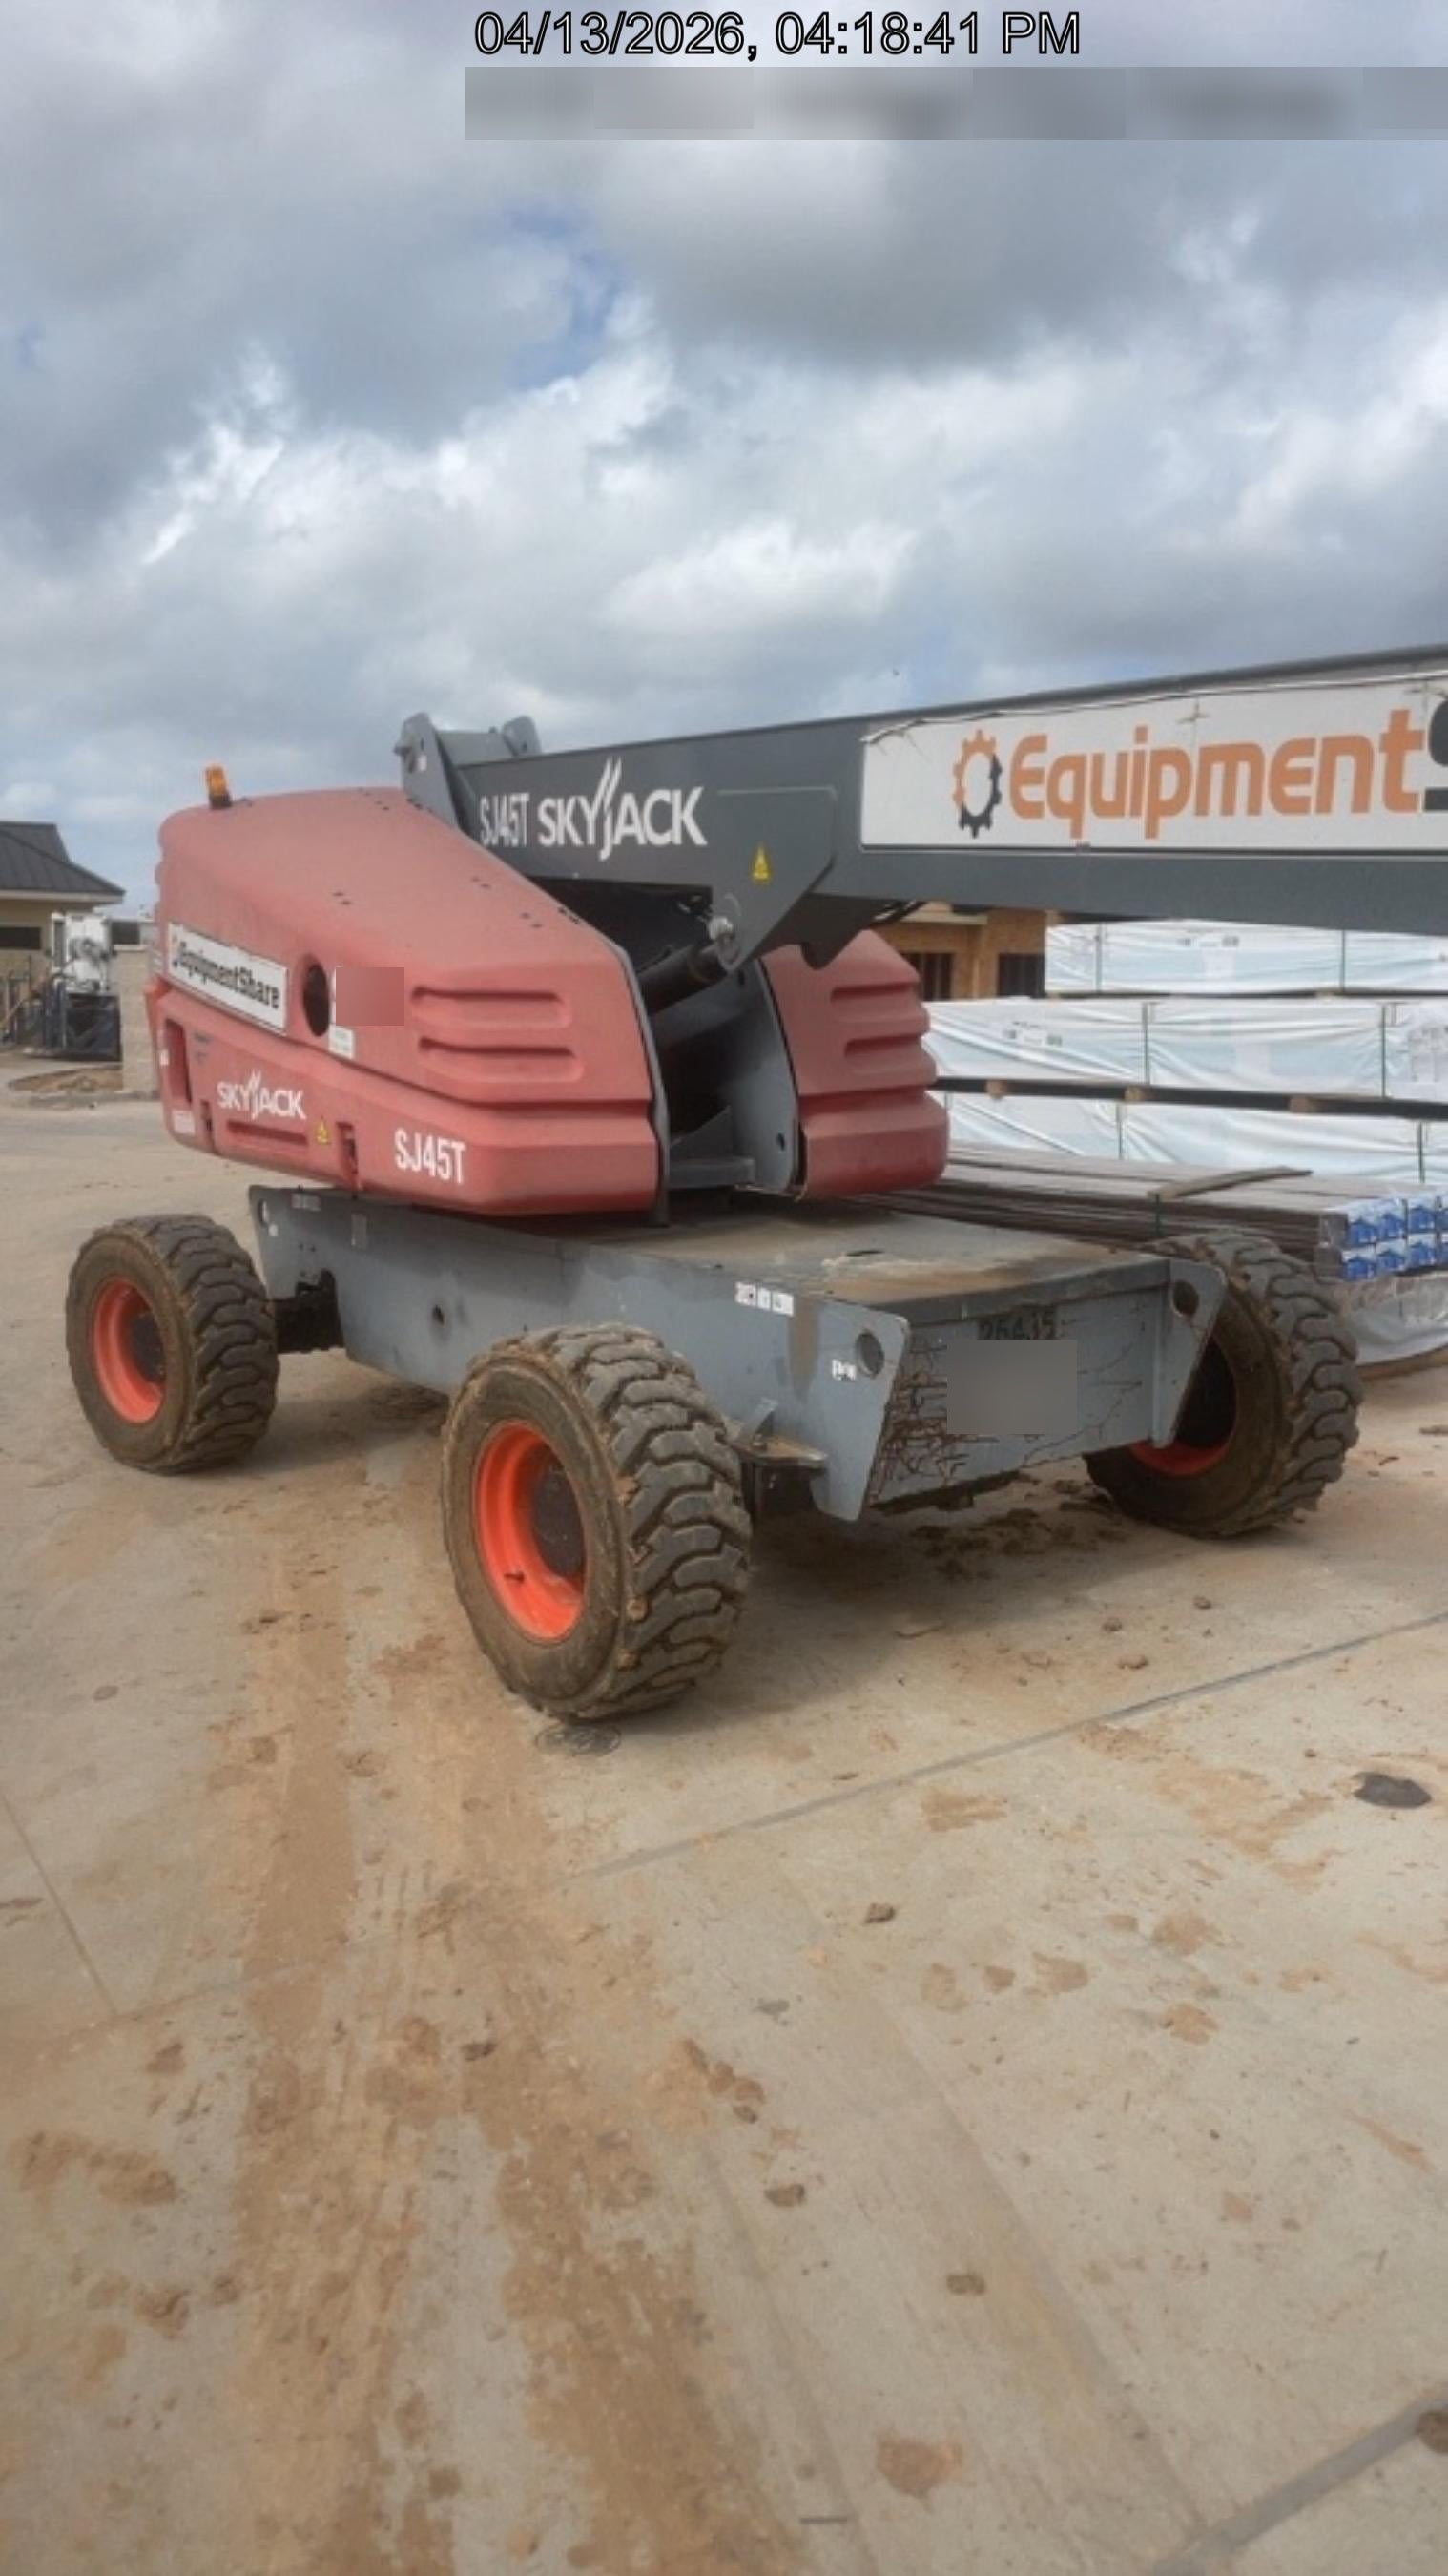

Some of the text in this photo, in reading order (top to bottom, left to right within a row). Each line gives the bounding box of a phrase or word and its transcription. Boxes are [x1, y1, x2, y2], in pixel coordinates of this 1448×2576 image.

[479, 757, 708, 862] SJ45T SKYJACK
[176, 940, 279, 1009] EquipmentShare
[217, 1070, 306, 1120] SKYJACK
[394, 1127, 465, 1184] SJ45T
